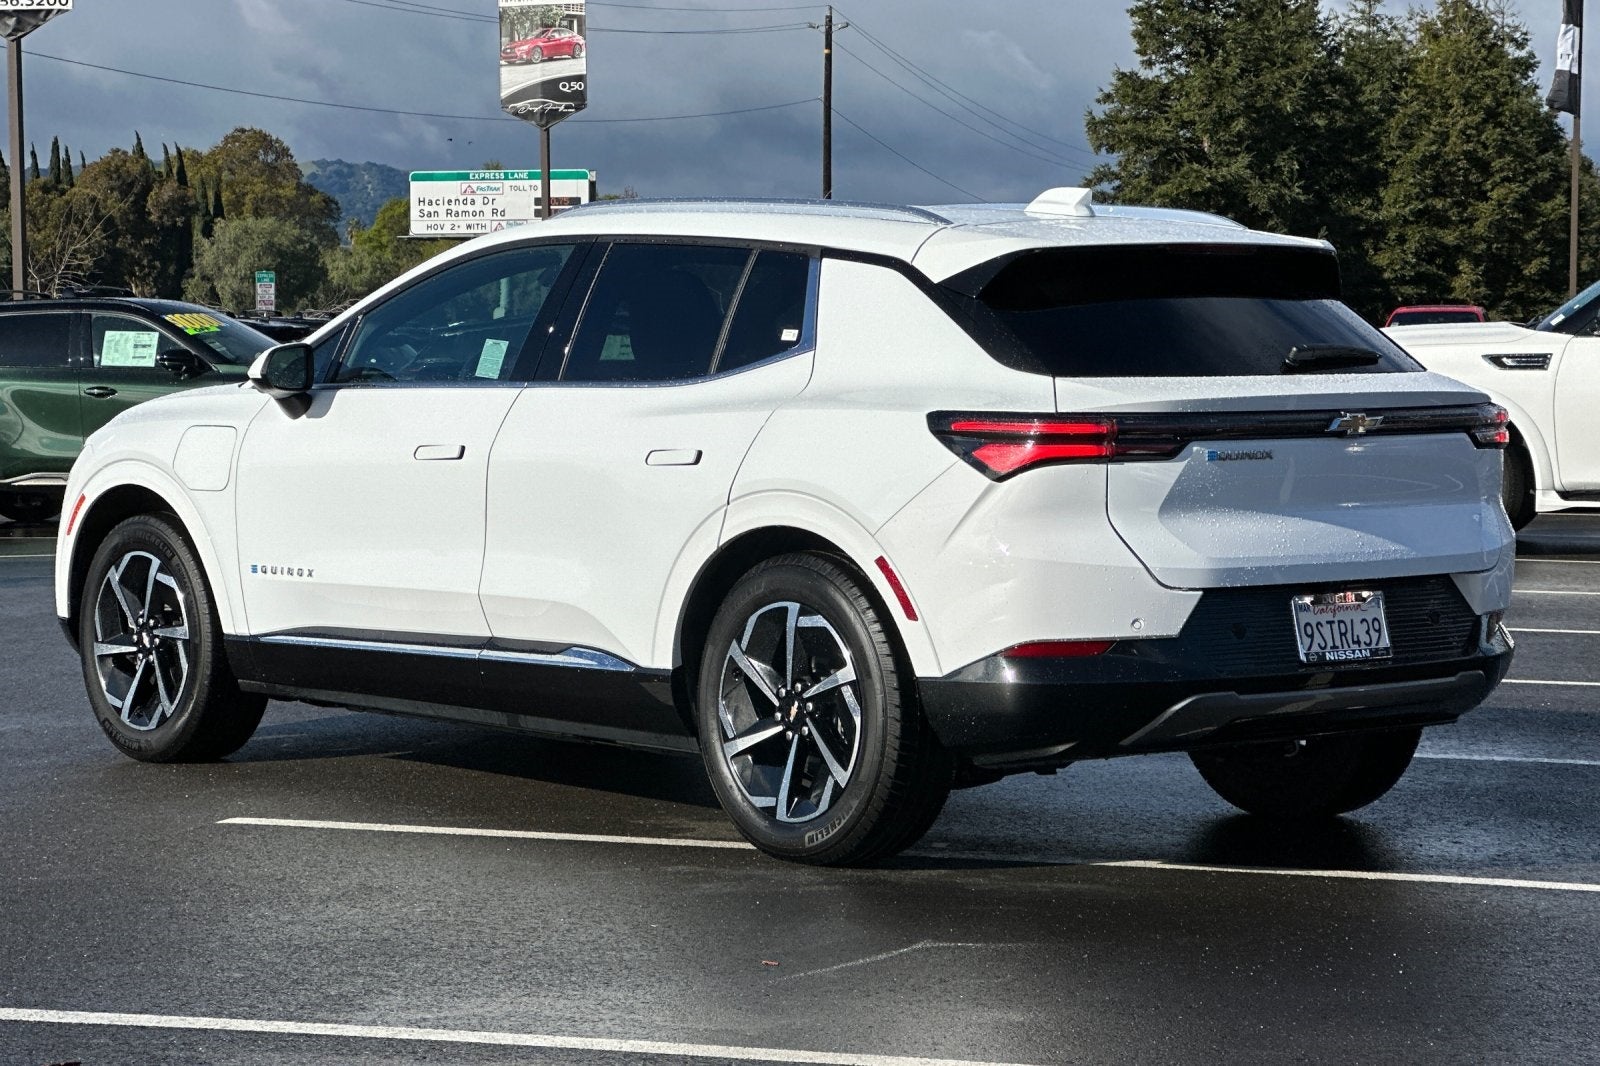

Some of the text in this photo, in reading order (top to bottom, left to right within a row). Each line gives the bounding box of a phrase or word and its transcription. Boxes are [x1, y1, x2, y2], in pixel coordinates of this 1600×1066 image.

[559, 82, 584, 92] Q50
[469, 172, 504, 180] EXPRESS
[418, 196, 476, 206] Hacienda
[482, 196, 496, 206] Dr
[418, 208, 506, 218] San Ramon Rd
[426, 223, 445, 231] HOV
[466, 222, 487, 230] WITH
[250, 564, 314, 578] EQUINOX
[1312, 603, 1368, 618] California
[1303, 617, 1382, 652] 9SIR439
[1325, 649, 1371, 661] NISSAN
